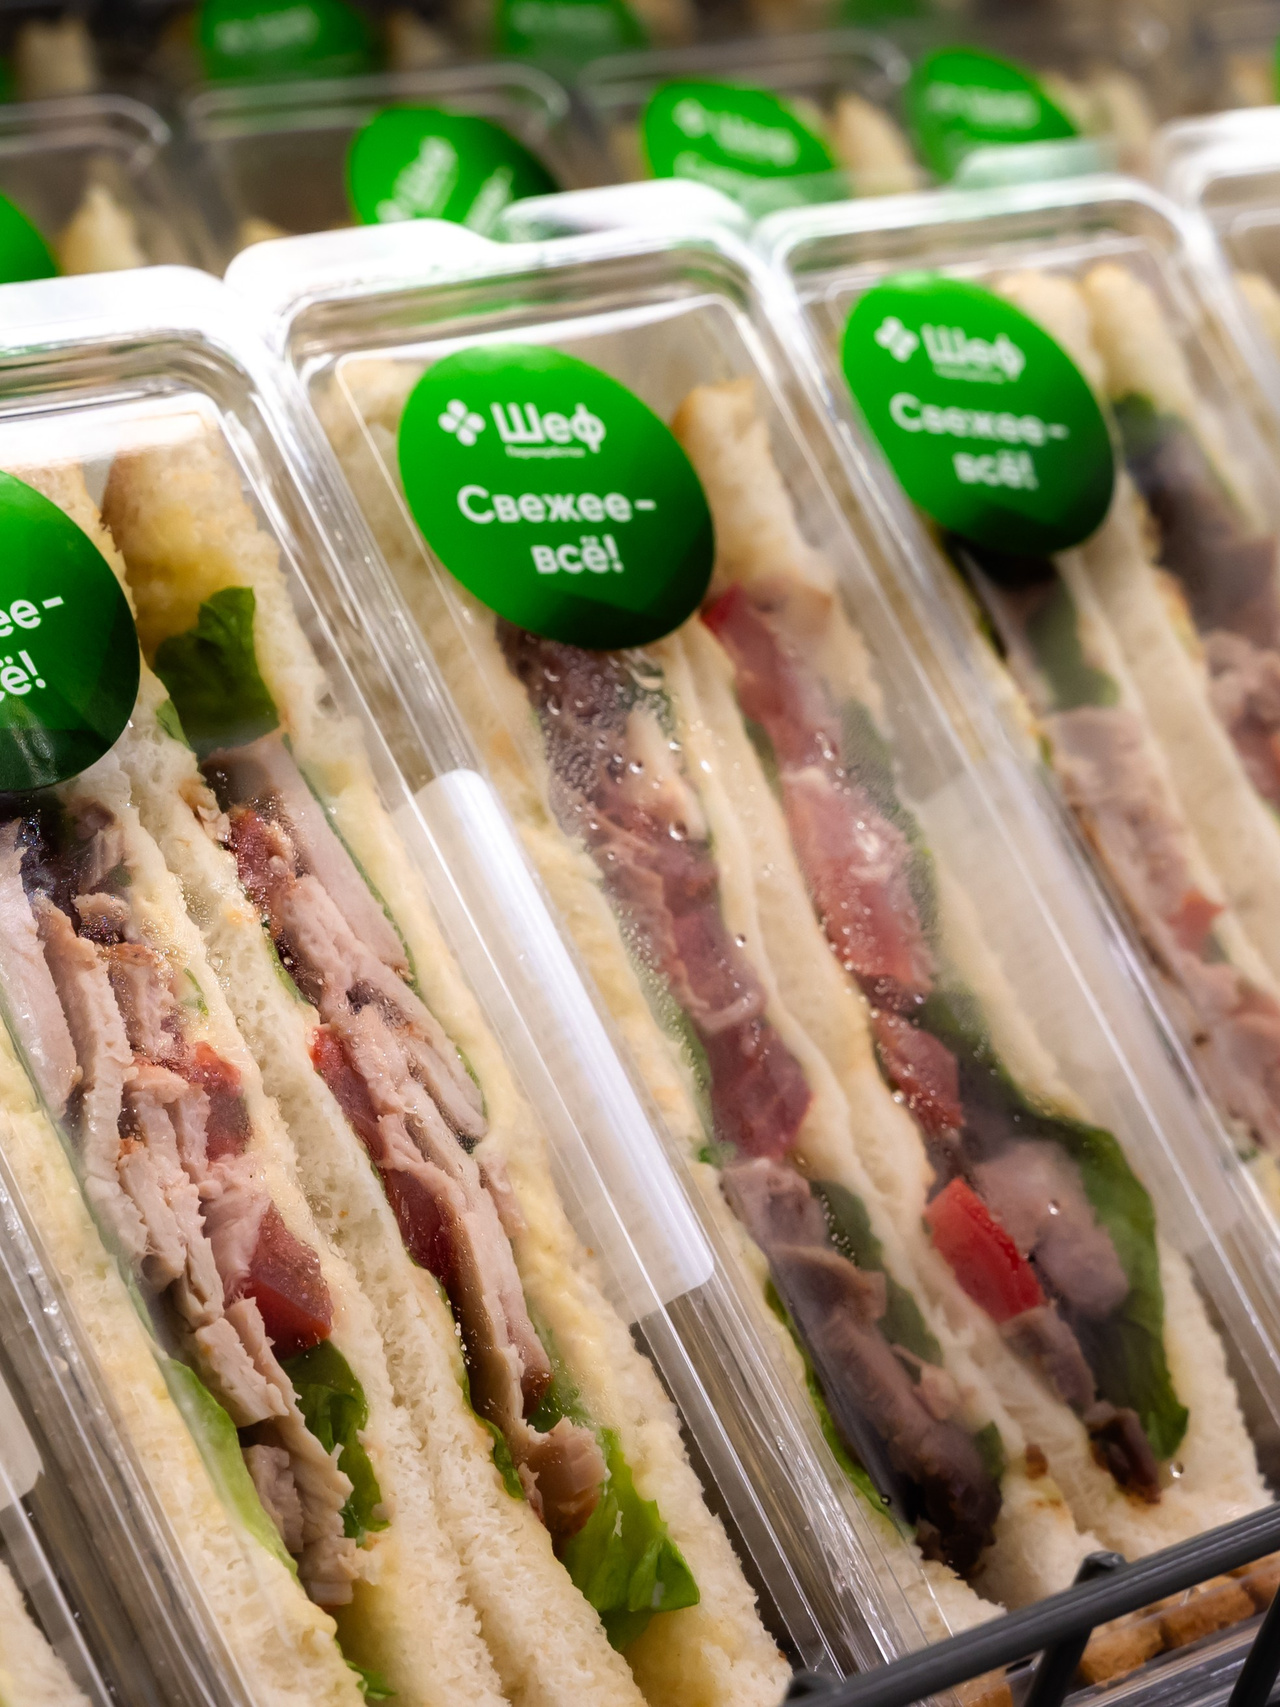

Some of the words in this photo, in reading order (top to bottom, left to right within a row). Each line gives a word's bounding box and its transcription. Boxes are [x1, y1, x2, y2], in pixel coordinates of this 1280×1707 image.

[921, 323, 1025, 382] Шеф
[491, 403, 605, 452] Шеф
[531, 535, 623, 573] всё!
